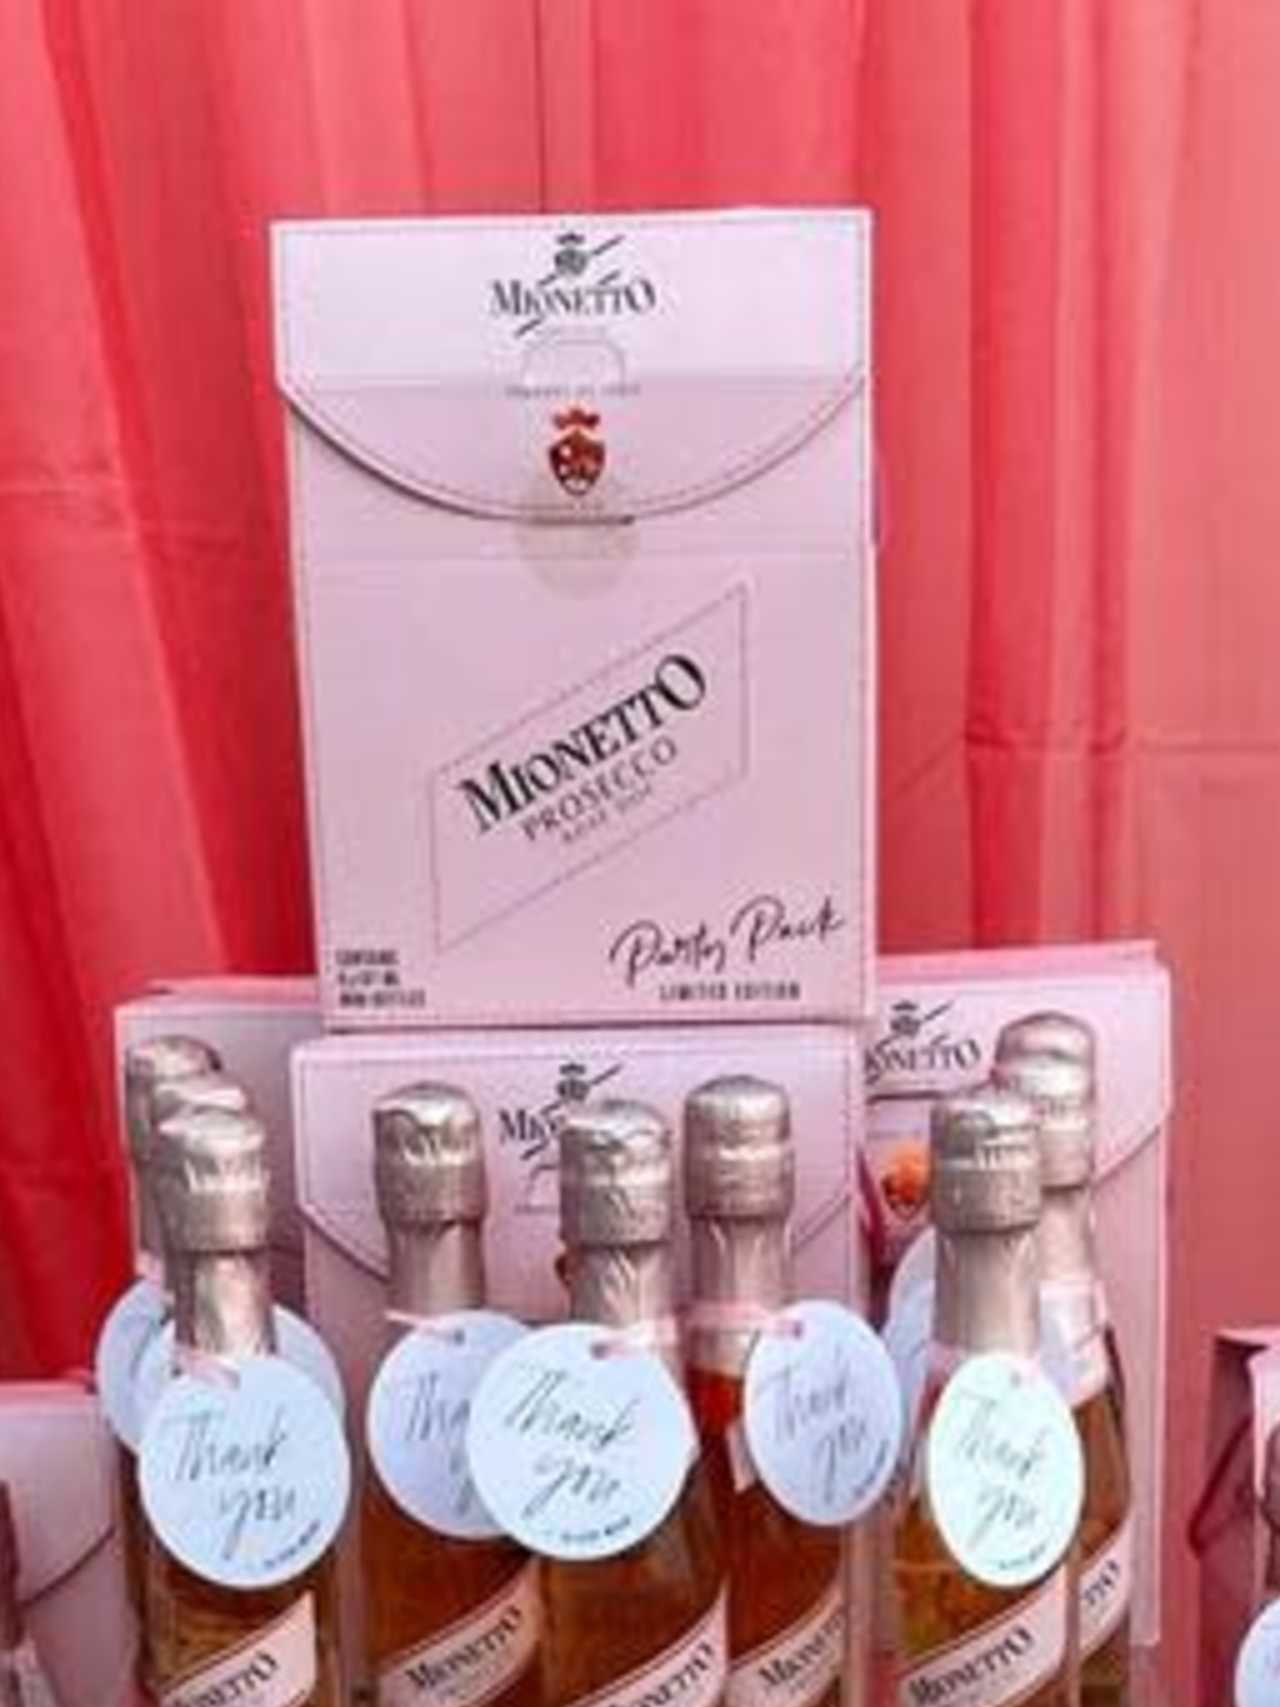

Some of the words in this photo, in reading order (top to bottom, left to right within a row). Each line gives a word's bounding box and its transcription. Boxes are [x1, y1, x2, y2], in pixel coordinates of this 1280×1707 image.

[489, 275, 657, 317] MIONETTO
[453, 652, 707, 833] MIONETTO
[521, 735, 678, 842] PROSECCO
[608, 919, 727, 988] Party
[730, 895, 845, 962] Pack
[156, 1402, 288, 1482] Thank
[505, 1363, 642, 1446] Thank
[217, 1488, 296, 1560] you
[523, 1456, 619, 1521] you
[908, 1627, 1033, 1704] MIONETTO
